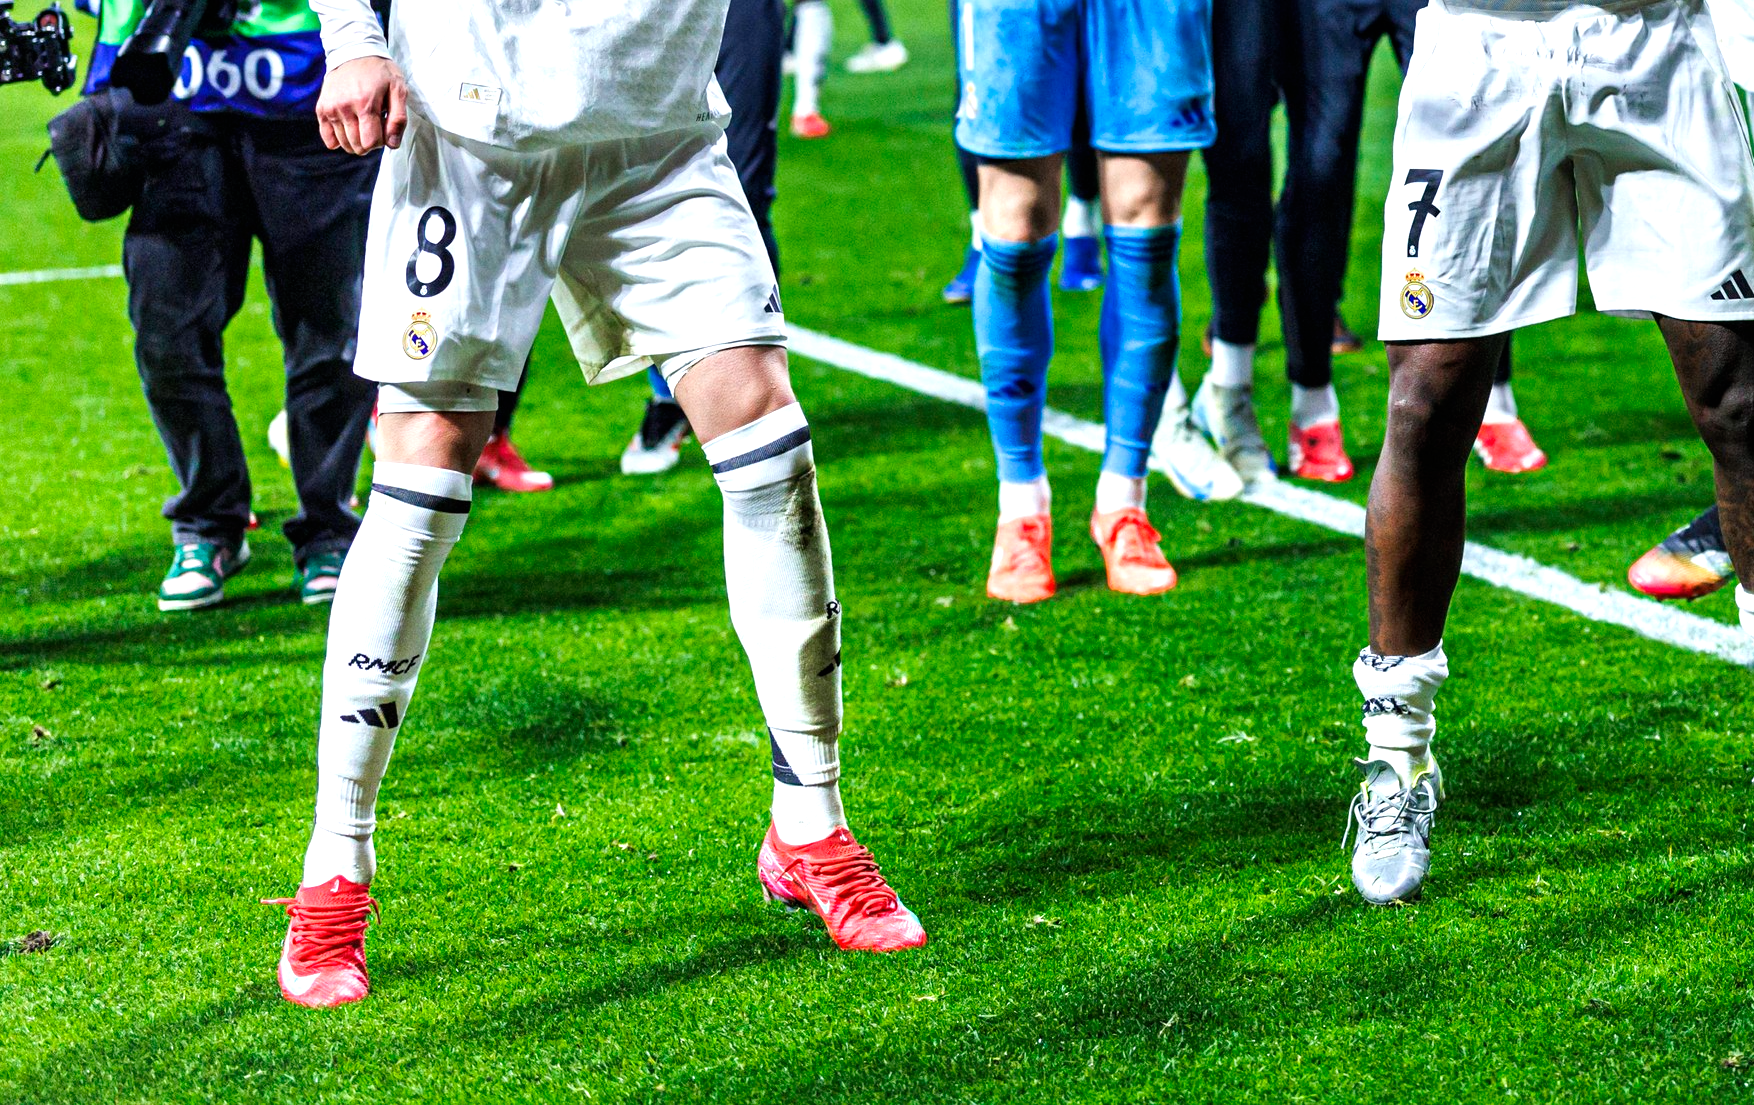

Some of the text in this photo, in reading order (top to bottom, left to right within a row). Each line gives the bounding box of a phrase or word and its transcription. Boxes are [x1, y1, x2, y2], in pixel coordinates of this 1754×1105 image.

[406, 206, 457, 297] 8
[1403, 169, 1444, 258] 7
[348, 653, 420, 675] RMCF
